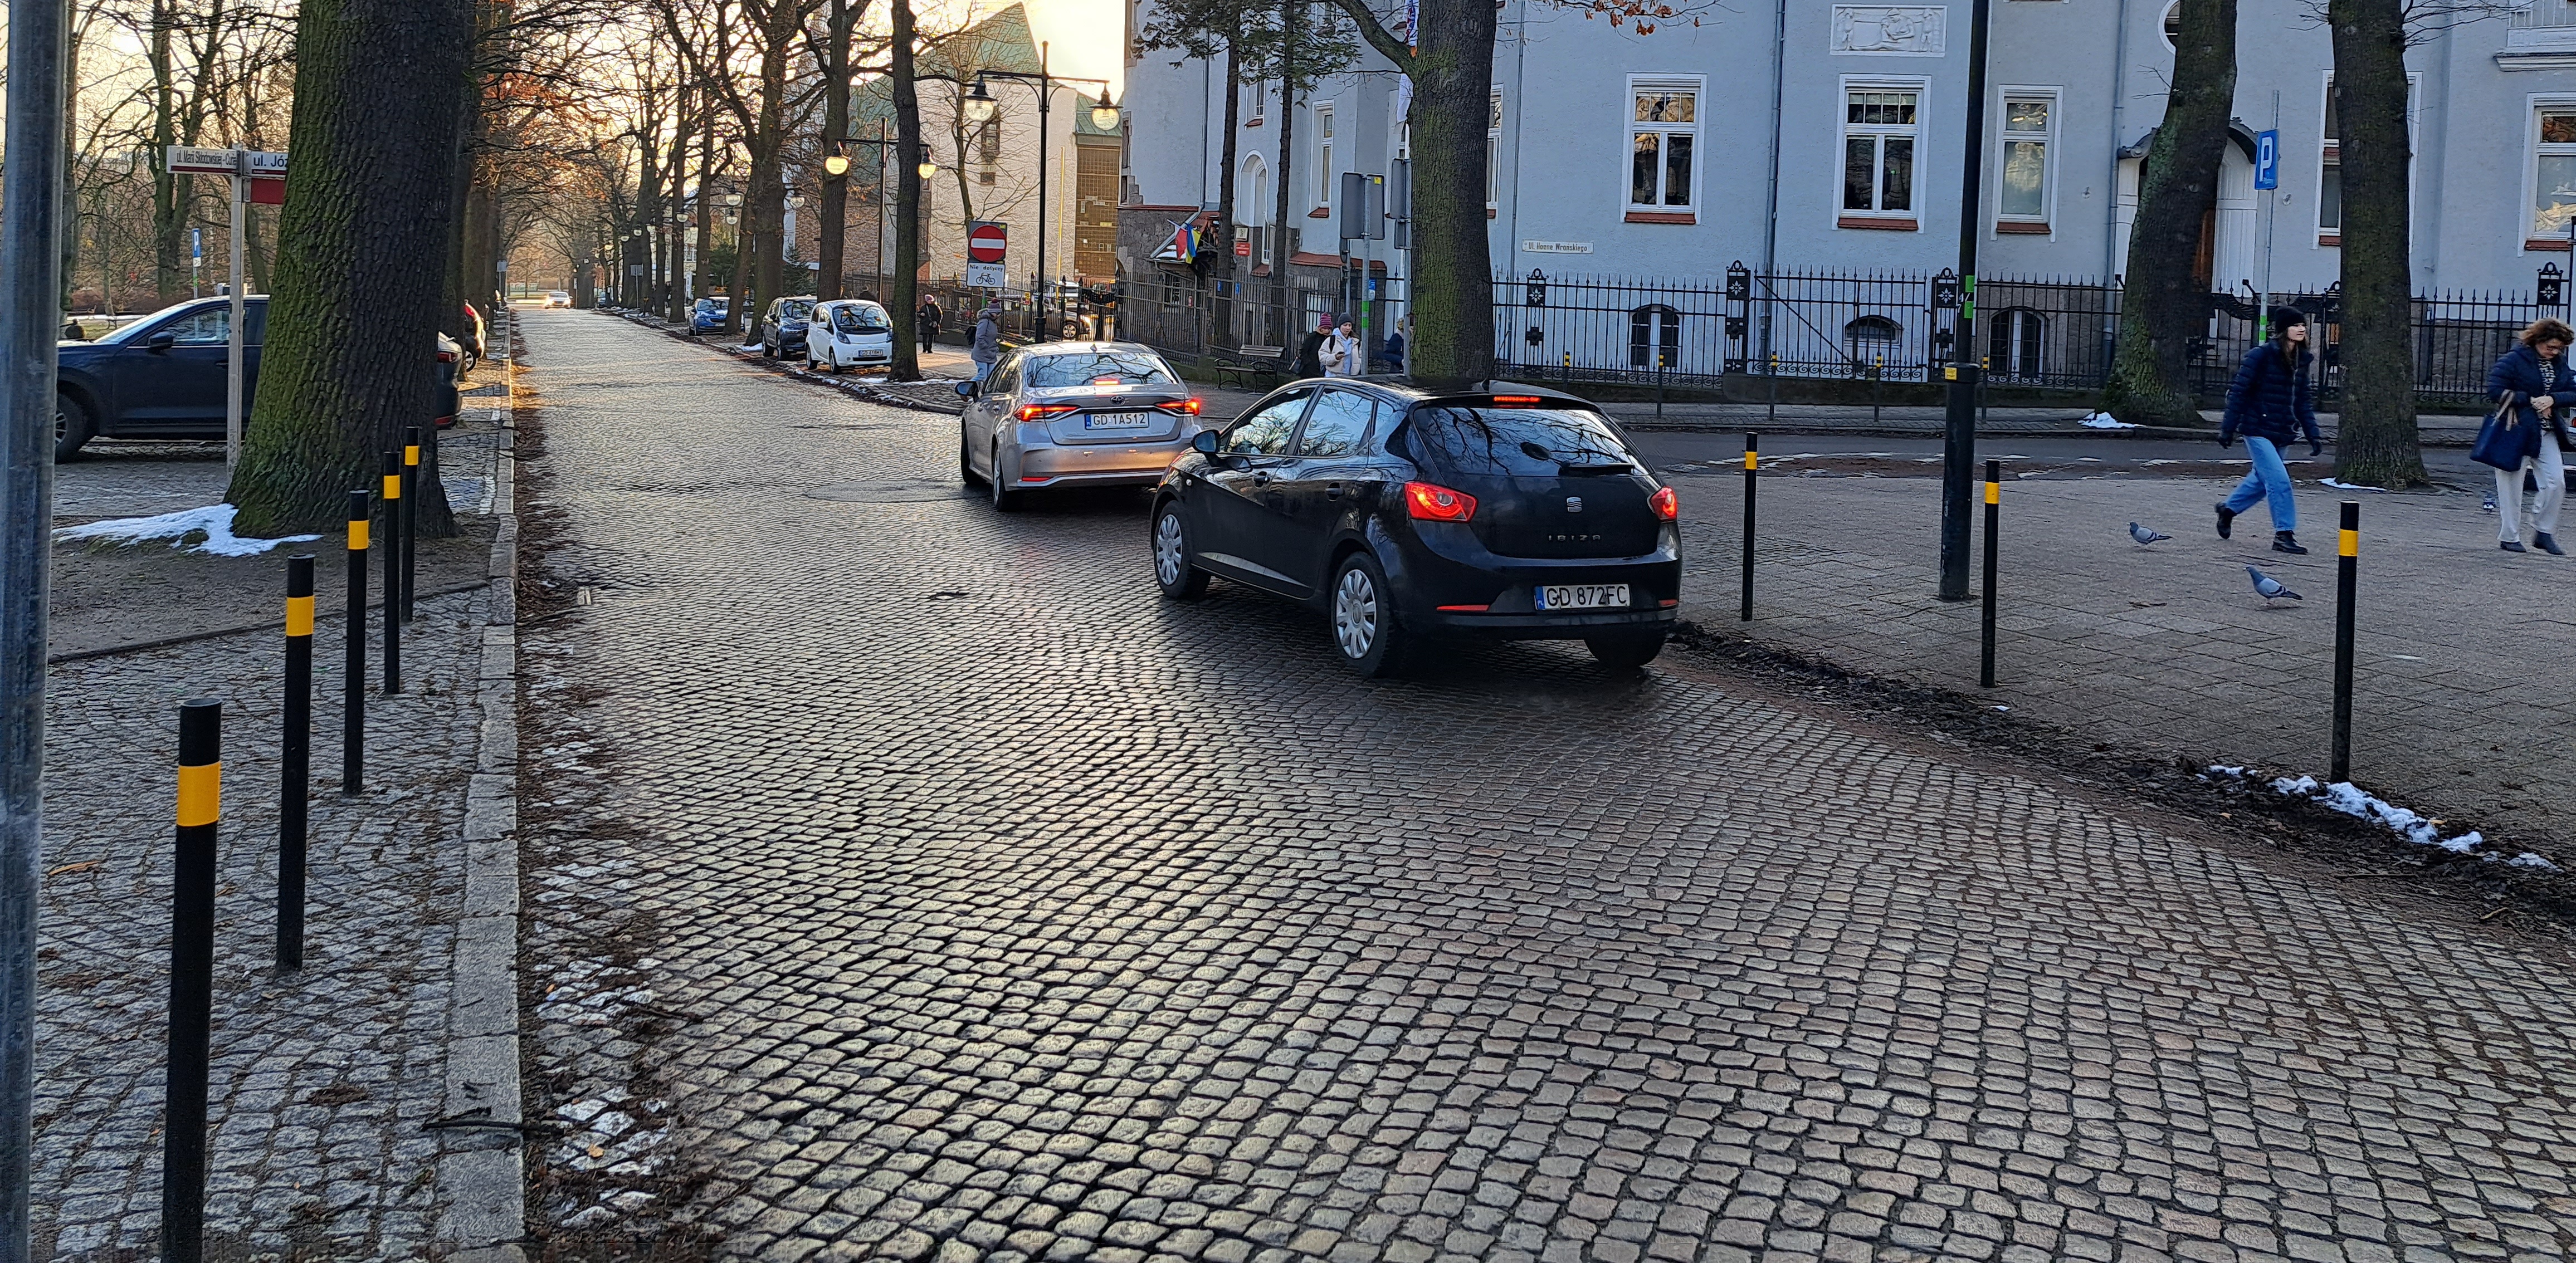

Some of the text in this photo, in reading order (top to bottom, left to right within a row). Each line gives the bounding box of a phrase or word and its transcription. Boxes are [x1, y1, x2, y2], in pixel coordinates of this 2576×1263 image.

[253, 154, 266, 167] ul.
[2259, 136, 2273, 182] P
[194, 232, 199, 251] P
[1555, 243, 1588, 252] Wrońskiego
[1094, 414, 1146, 425] GD 1A512
[1546, 586, 1627, 606] GD 872FC
